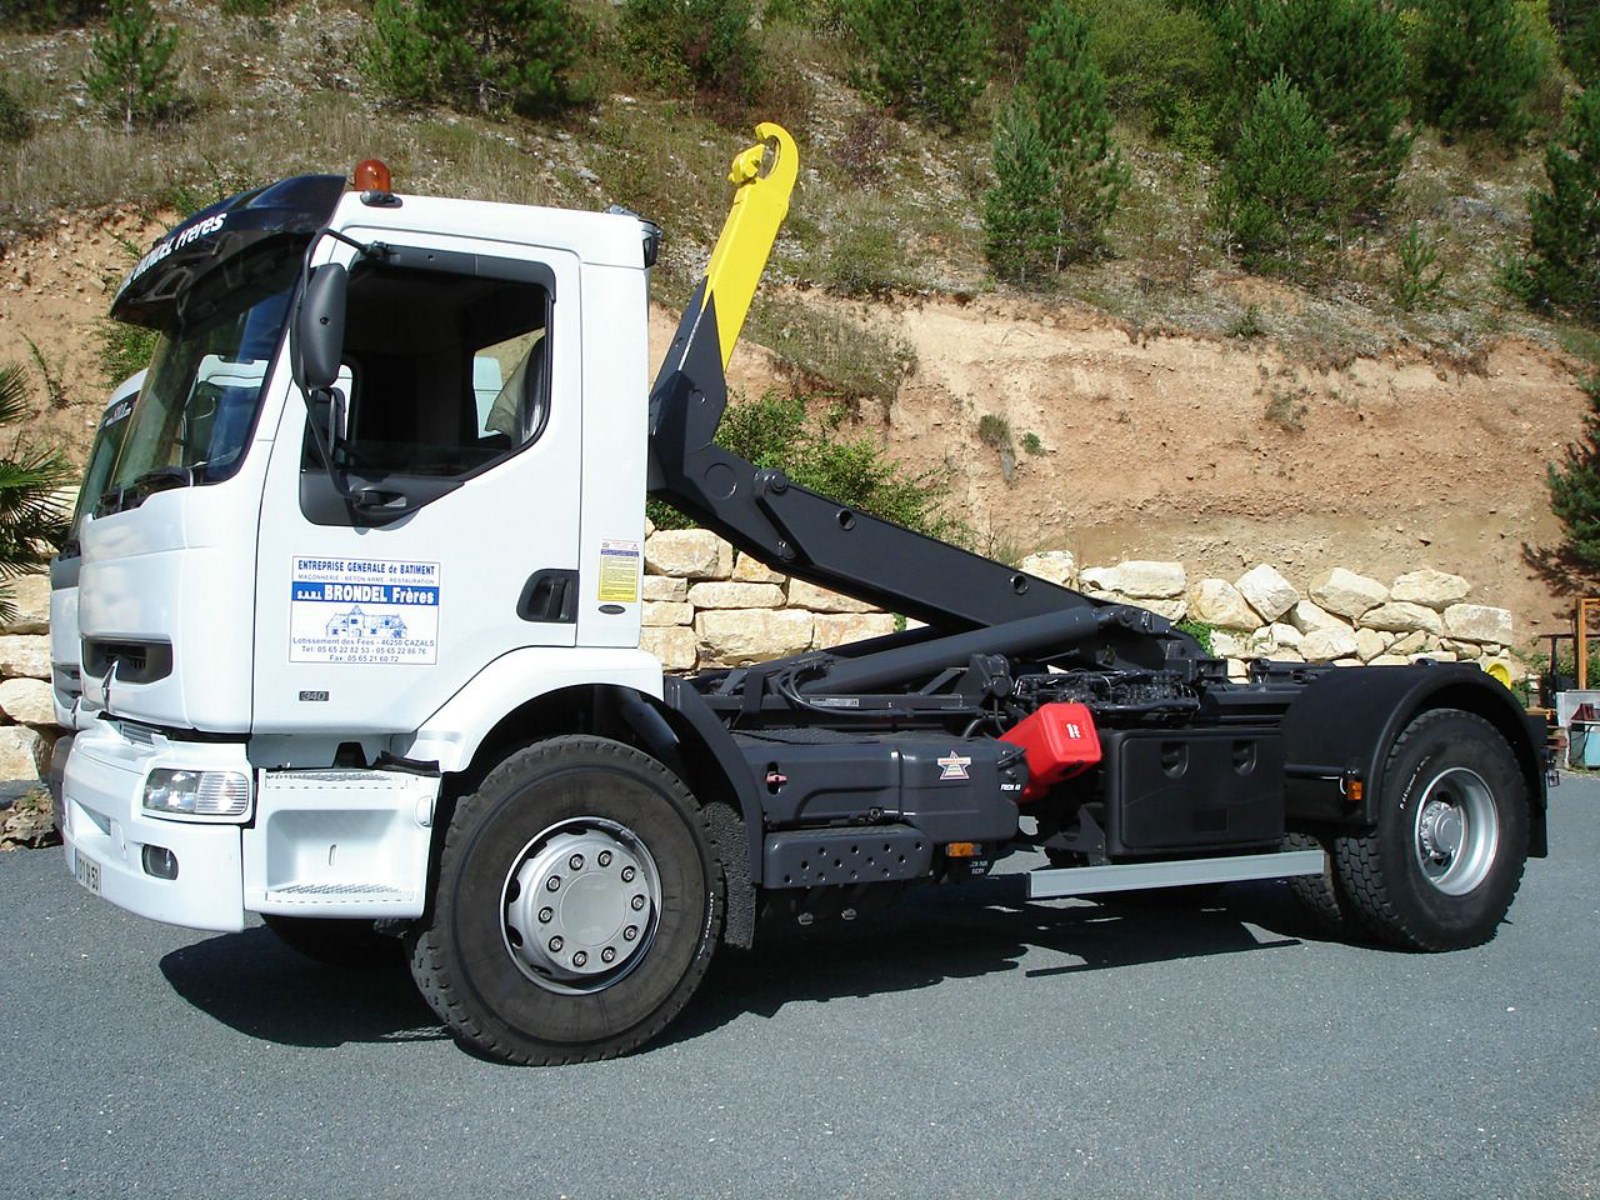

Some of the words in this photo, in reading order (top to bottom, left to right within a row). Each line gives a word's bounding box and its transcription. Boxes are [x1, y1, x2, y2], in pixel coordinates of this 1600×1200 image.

[298, 560, 344, 572] ENTREPRISE
[388, 564, 397, 574] de
[400, 565, 435, 576] BATIMENT
[324, 584, 388, 603] BRONDEL
[392, 586, 435, 604] Frères
[293, 637, 340, 645] Lotissement
[341, 638, 354, 646] des
[302, 691, 327, 701] 340
